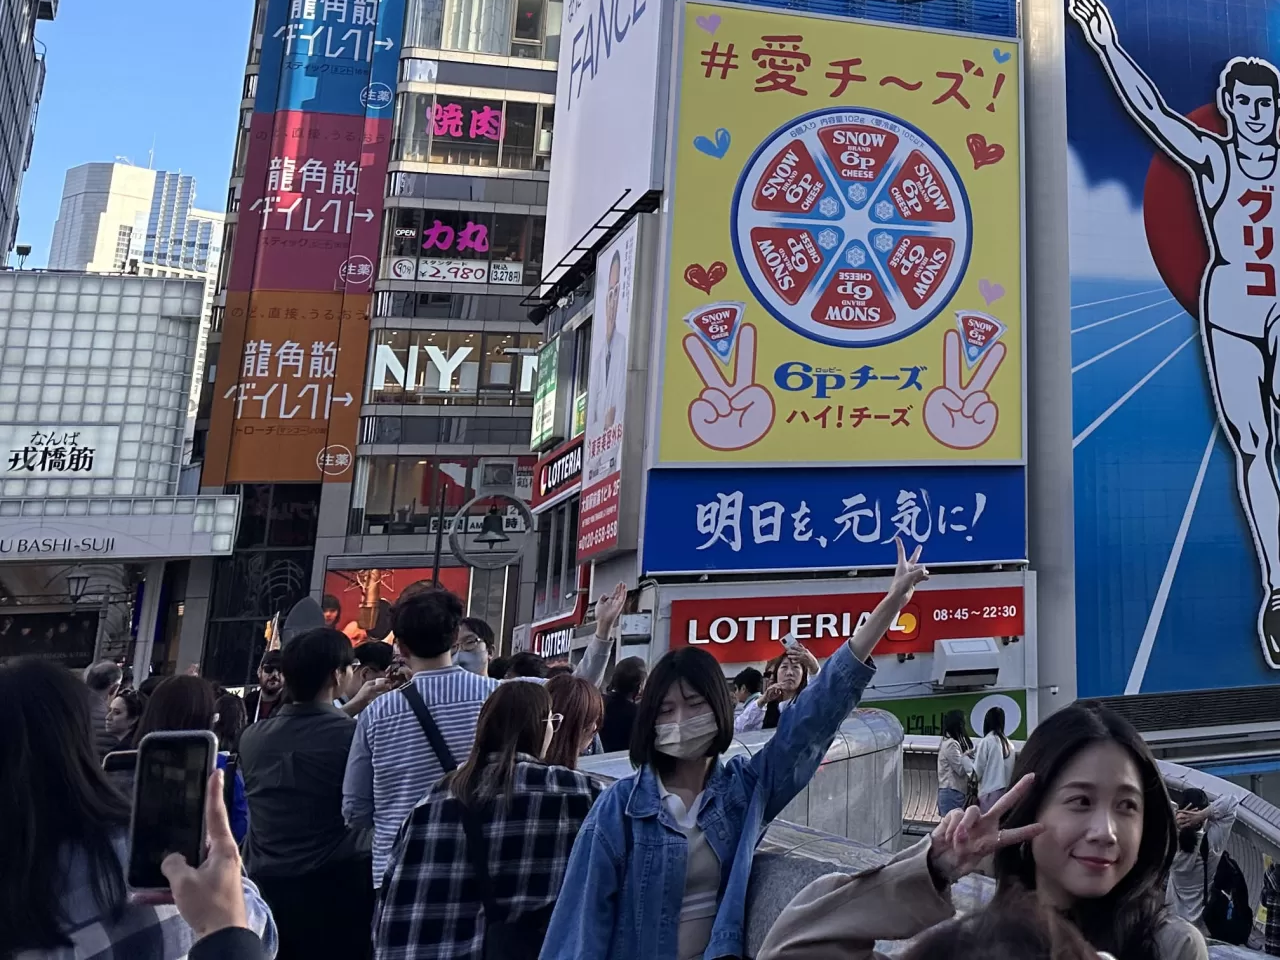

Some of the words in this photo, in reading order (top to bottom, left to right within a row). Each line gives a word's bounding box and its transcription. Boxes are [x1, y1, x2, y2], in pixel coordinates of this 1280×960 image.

[272, 23, 382, 62] ダイレクト
[362, 90, 390, 102] 生薬
[426, 103, 506, 141] 焼肉
[833, 130, 886, 147] SNOW
[267, 157, 362, 196] 龍角散
[761, 149, 799, 200] SNOW
[782, 170, 798, 192] BRAND
[841, 169, 874, 179] CHEESE
[914, 162, 950, 211] SNOW
[801, 181, 824, 211] CHEESE
[891, 187, 912, 218] CHEESE
[916, 181, 930, 203] BRAND
[249, 196, 365, 234] ダイレクト
[395, 229, 416, 237] OPEN
[422, 220, 489, 252] 力丸
[800, 231, 821, 264] CHEESE
[1237, 185, 1276, 297] グリコ
[757, 239, 795, 291] SNOW
[778, 248, 794, 272] BRAND
[889, 238, 910, 268] CHEESE
[914, 256, 929, 278] BRAND
[342, 263, 371, 277] 生薬
[839, 271, 872, 281] CHEESE
[912, 247, 946, 300] SNOW
[702, 310, 730, 324] SNOW
[825, 307, 881, 323] SNOW
[968, 319, 993, 331] SNOW
[242, 339, 341, 378] 龍角散
[372, 344, 474, 392] NY
[223, 383, 343, 420] ダイレクト
[786, 404, 913, 428] ハイ!チーズ
[29, 431, 80, 446] なんば
[7, 446, 96, 472] 戎橋筋
[319, 453, 350, 467] 生薬
[548, 446, 582, 489] LOTTERIA
[17, 537, 116, 554] BASHI-SUJI
[687, 611, 871, 645] LOTTERIA
